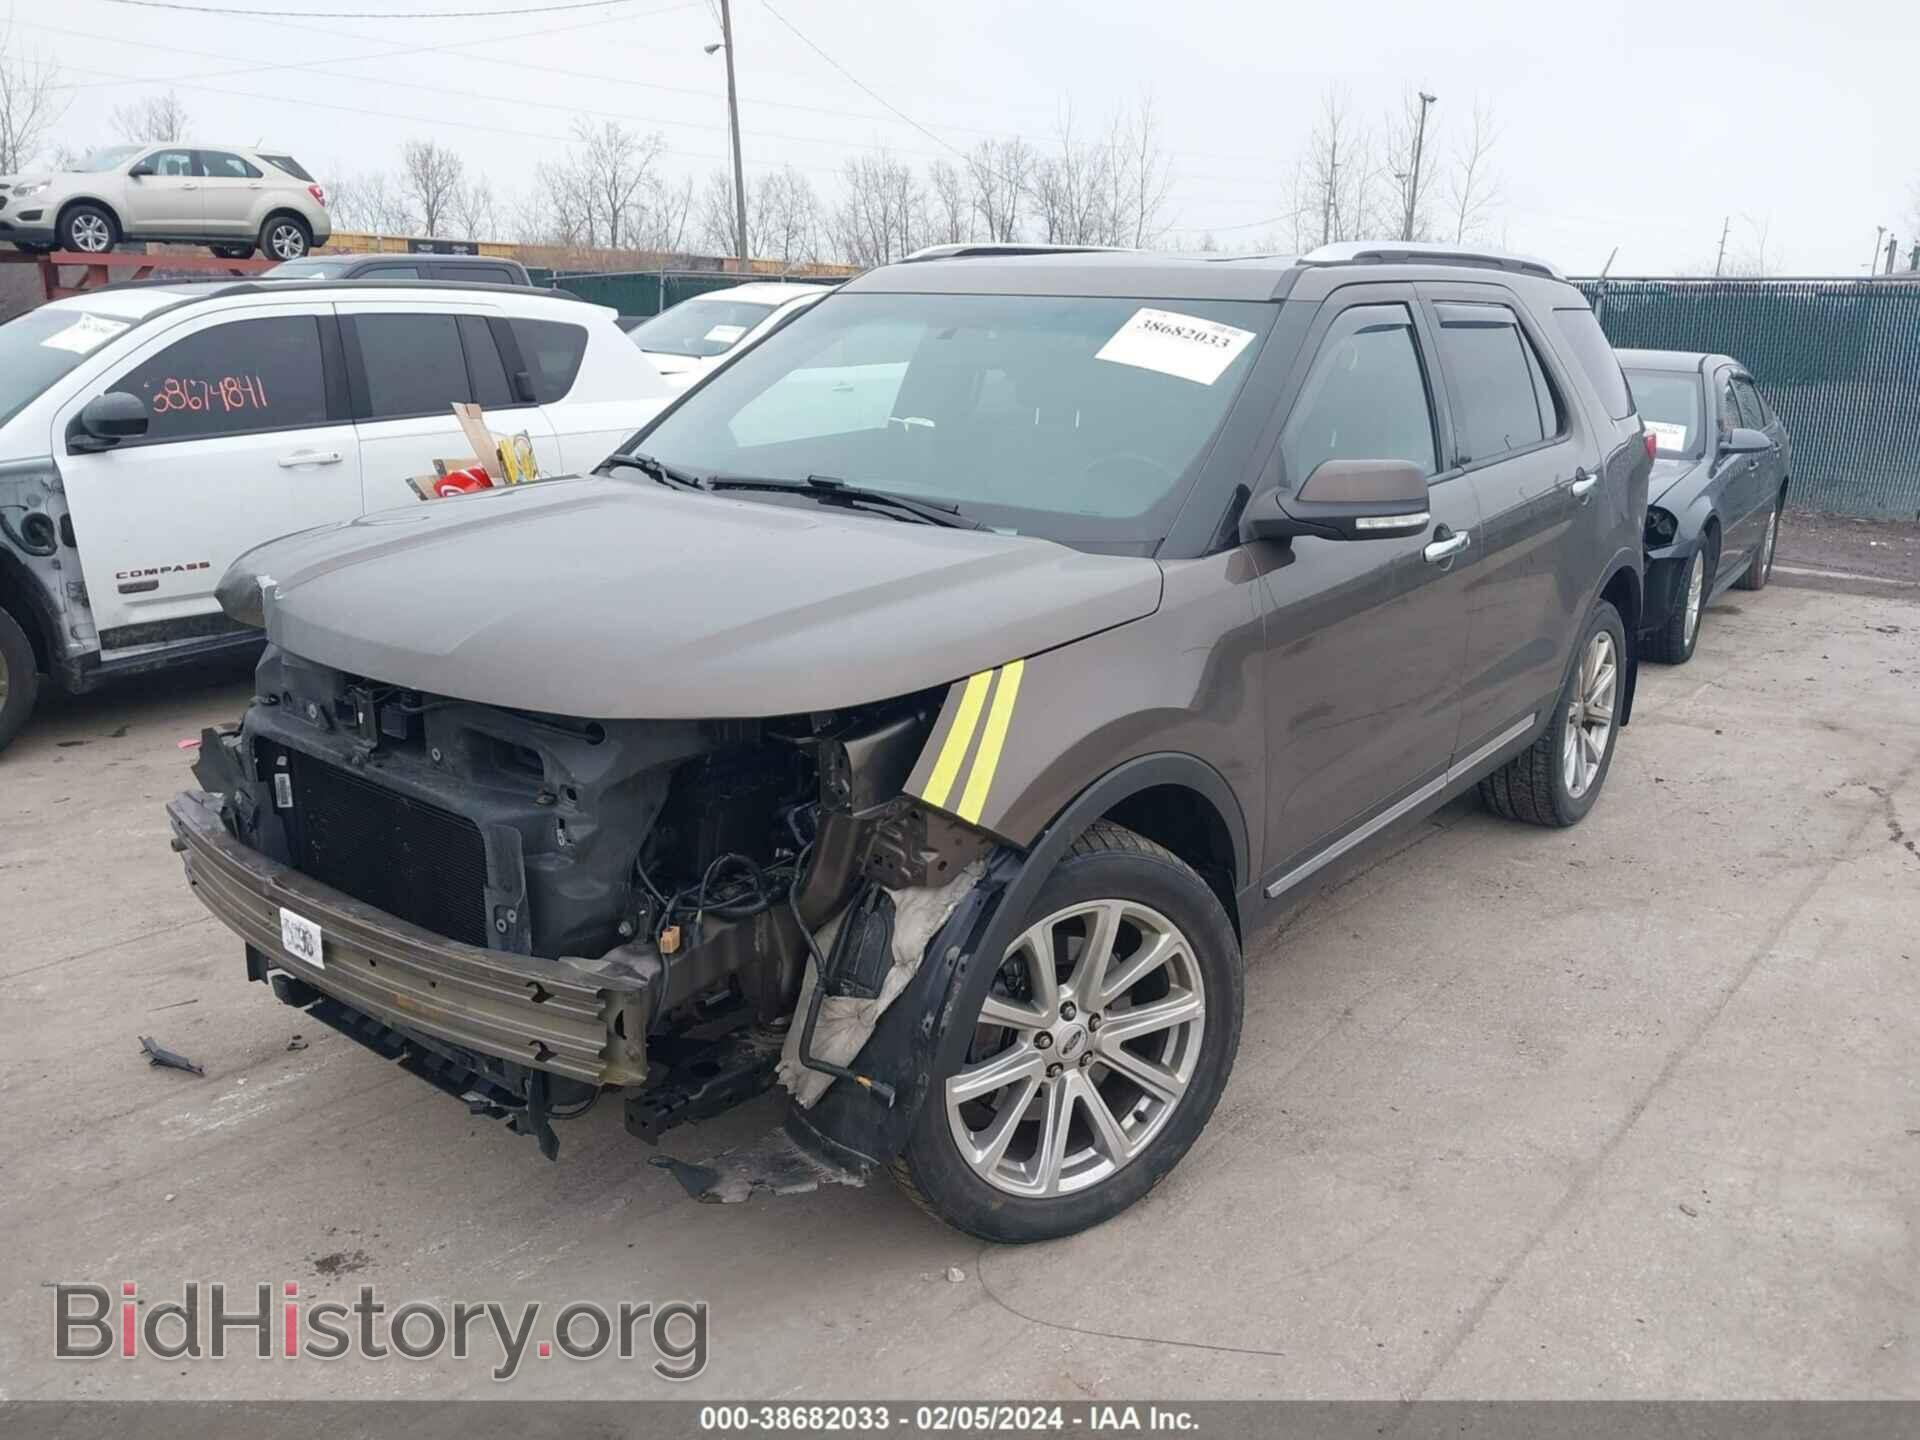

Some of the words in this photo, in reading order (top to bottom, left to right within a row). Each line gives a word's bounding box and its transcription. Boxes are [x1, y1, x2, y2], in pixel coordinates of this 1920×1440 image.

[1138, 319, 1231, 348] 38682033
[150, 375, 268, 412] 38674841
[116, 561, 210, 579] COMPASS
